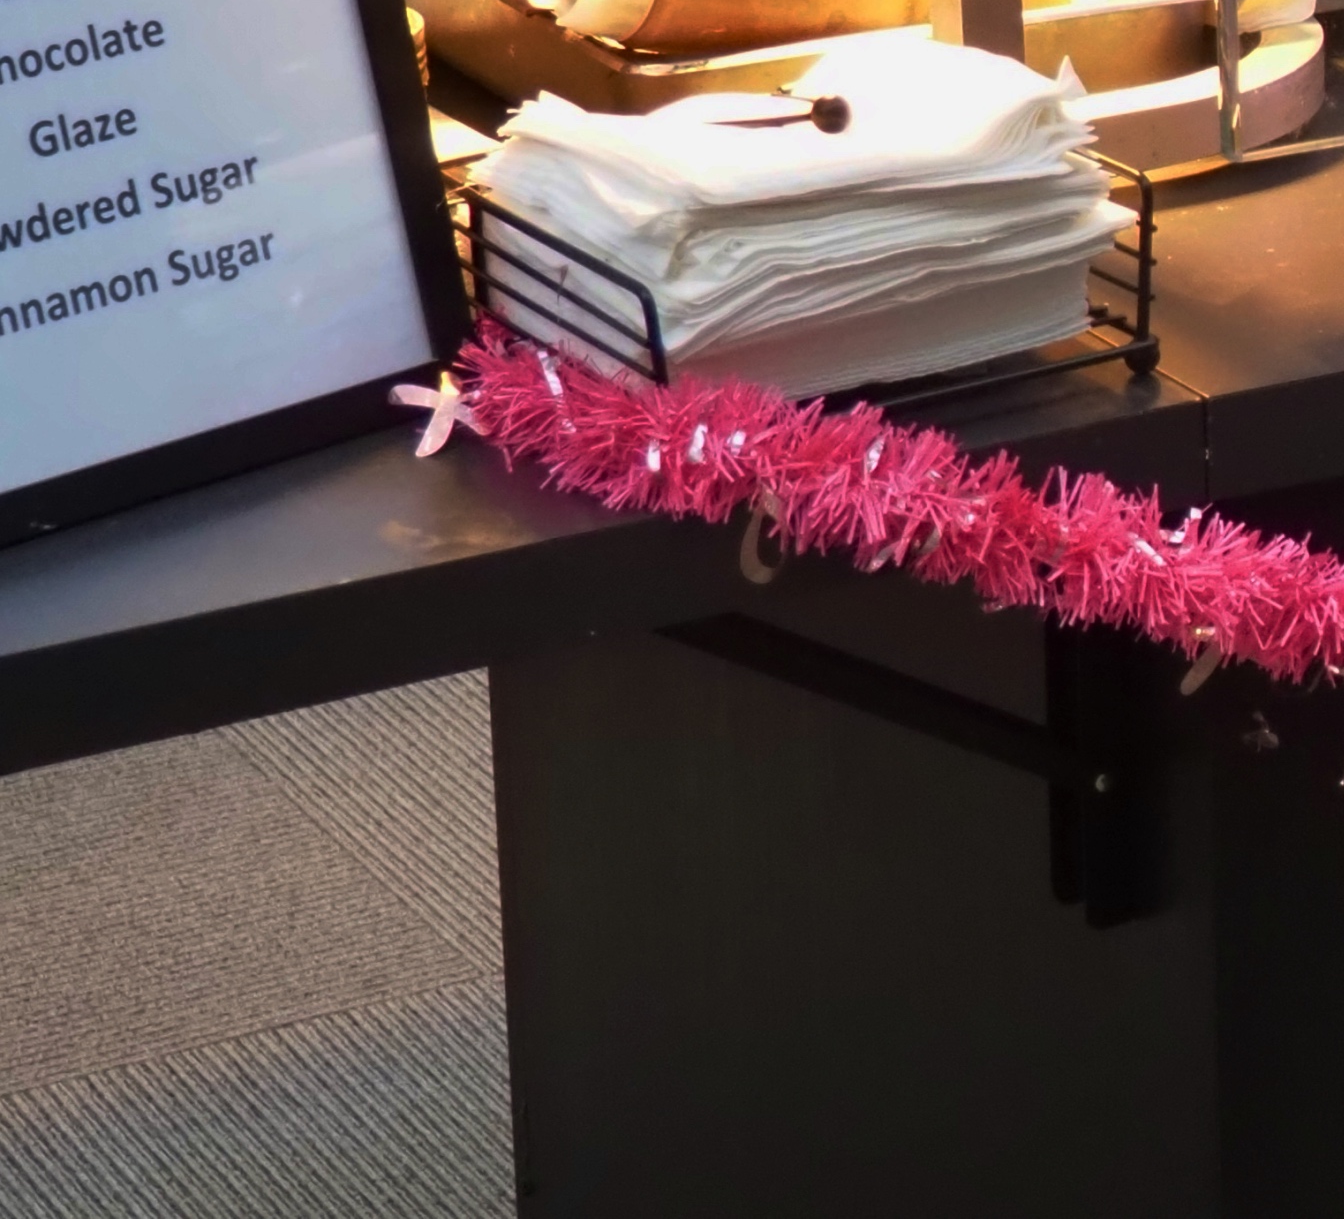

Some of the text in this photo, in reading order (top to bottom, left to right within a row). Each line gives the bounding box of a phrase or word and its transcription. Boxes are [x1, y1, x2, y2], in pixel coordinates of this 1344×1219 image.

[28, 108, 138, 158] Glaze
[0, 156, 258, 252] wdered Sugar
[0, 233, 274, 337] nnamon Sugar
